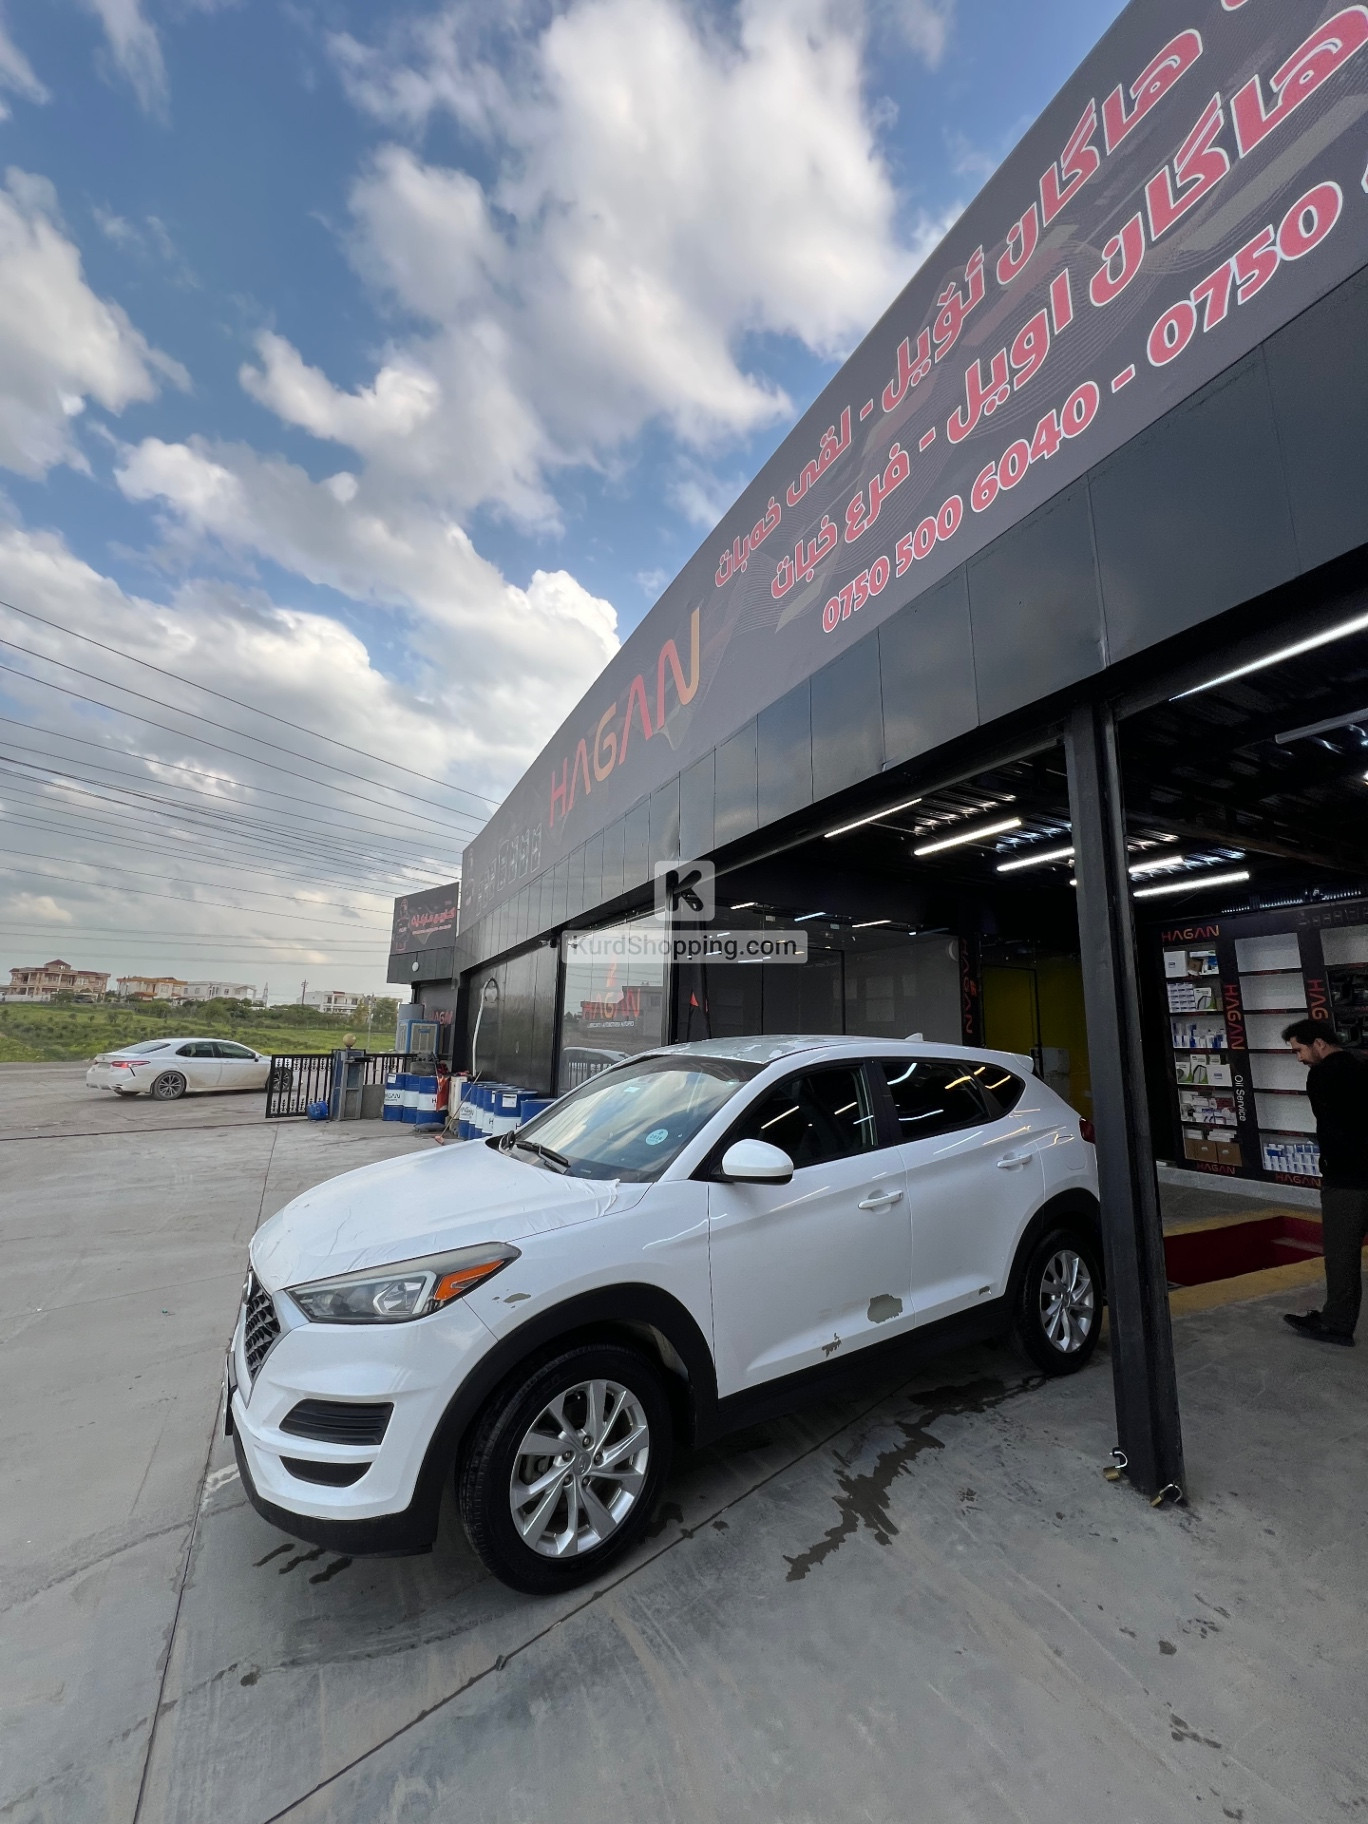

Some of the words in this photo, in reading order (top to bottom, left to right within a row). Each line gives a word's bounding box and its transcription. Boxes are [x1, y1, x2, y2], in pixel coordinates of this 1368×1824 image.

[822, 555, 890, 633] 0750
[895, 494, 964, 578] 500
[971, 380, 1100, 513] 6040
[1147, 180, 1342, 366] 0750
[844, 442, 911, 543] فرع
[771, 514, 838, 599] خبات
[549, 606, 700, 828] HAGAN
[1161, 924, 1220, 943] HAGAN
[1223, 984, 1246, 1050] HAGAN
[1307, 978, 1329, 1021] HAG
[1235, 1074, 1244, 1088] Oil
[1236, 1089, 1247, 1122] Service
[1196, 1162, 1236, 1175] HAGAN
[1275, 1173, 1323, 1188] HAGAN
